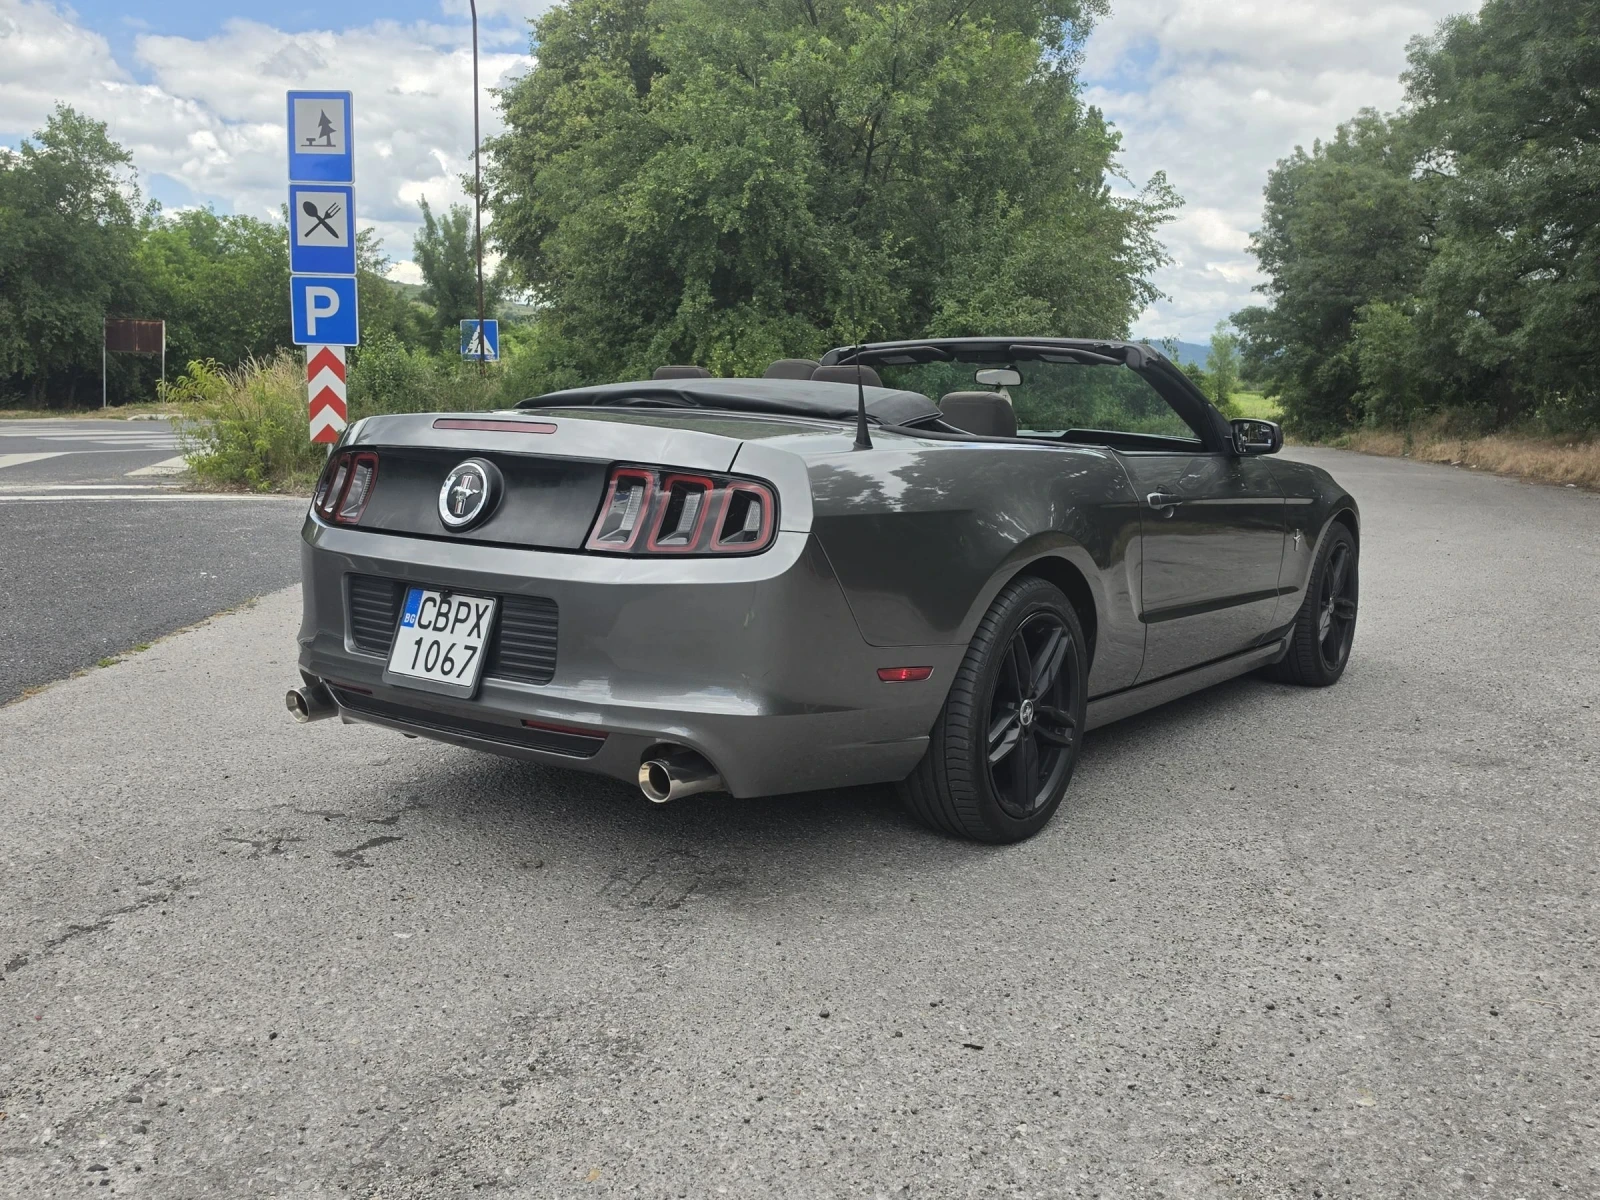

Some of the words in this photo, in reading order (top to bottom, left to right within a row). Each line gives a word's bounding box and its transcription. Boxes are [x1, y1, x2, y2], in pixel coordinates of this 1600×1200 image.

[305, 285, 340, 336] P
[404, 613, 416, 623] BG
[417, 596, 490, 639] CBPX
[411, 637, 479, 679] 1067
